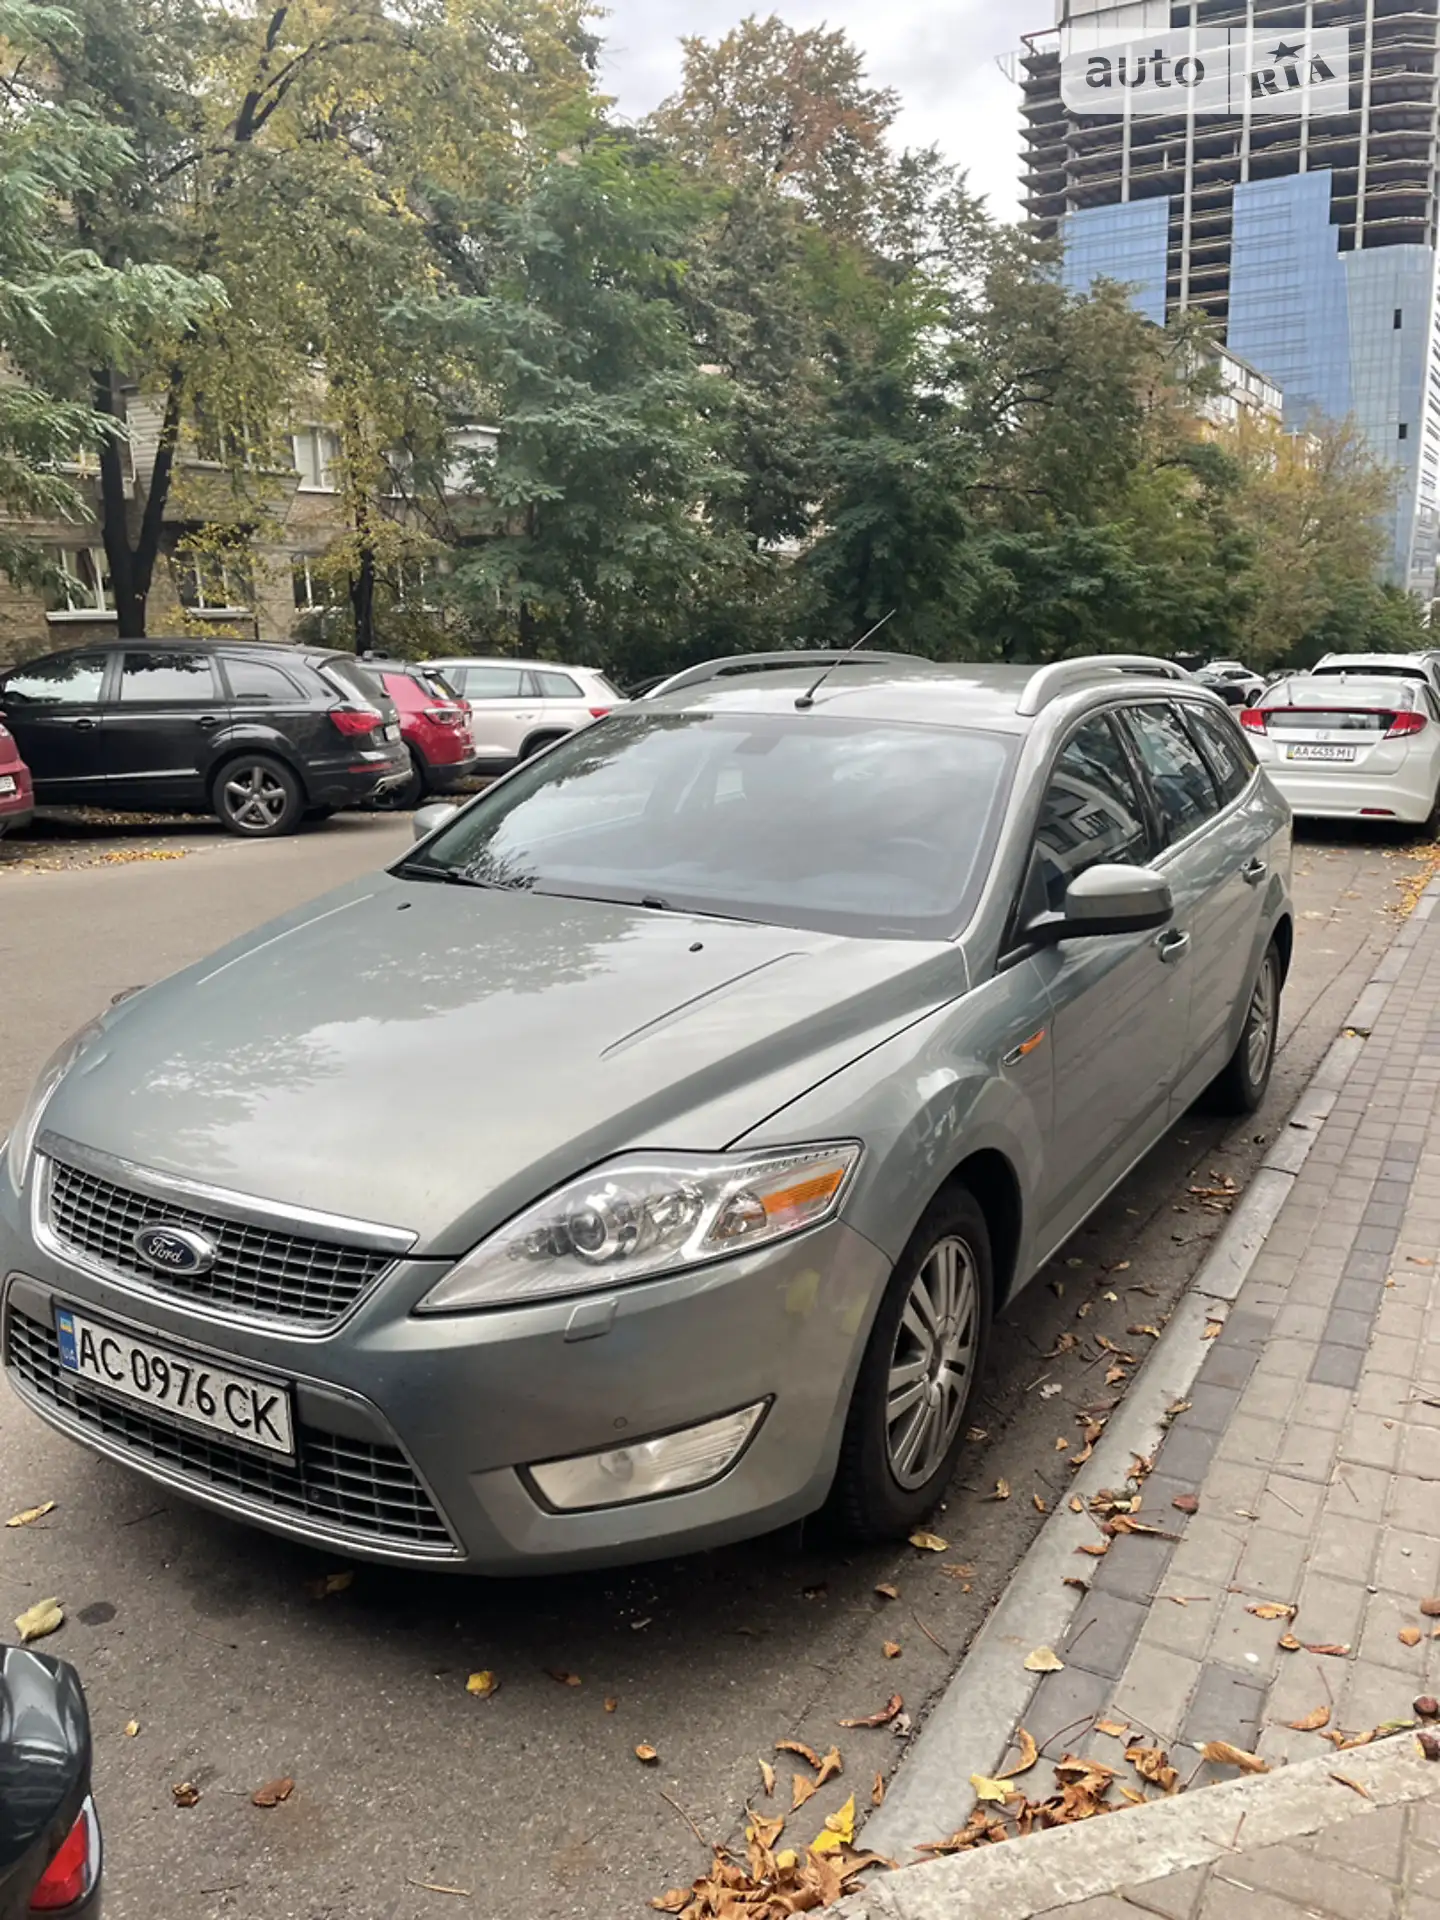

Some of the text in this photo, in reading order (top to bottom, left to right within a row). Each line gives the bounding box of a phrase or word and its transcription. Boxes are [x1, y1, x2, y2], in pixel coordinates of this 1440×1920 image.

[1294, 745, 1308, 757] AA
[148, 1236, 184, 1263] Ford
[80, 1327, 282, 1442] AC 0976 CK
